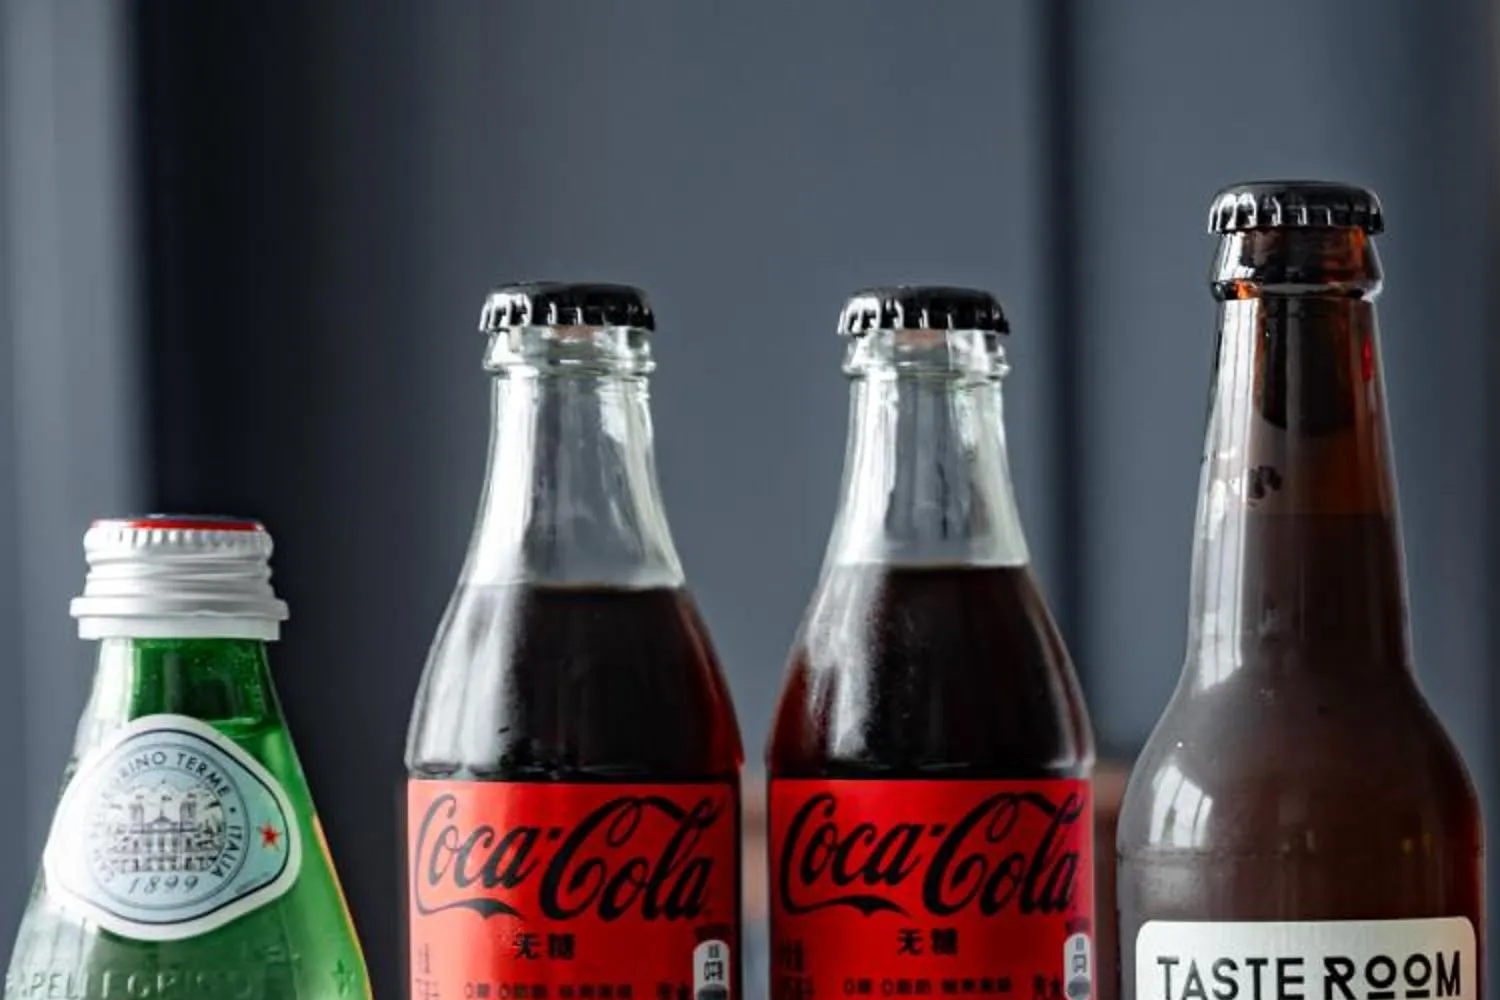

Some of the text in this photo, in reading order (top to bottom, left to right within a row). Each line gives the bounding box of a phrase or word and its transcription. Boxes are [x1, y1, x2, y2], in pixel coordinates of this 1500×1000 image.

[175, 752, 232, 798] TERME
[209, 825, 244, 880] ITALIA
[128, 874, 200, 896] 1899
